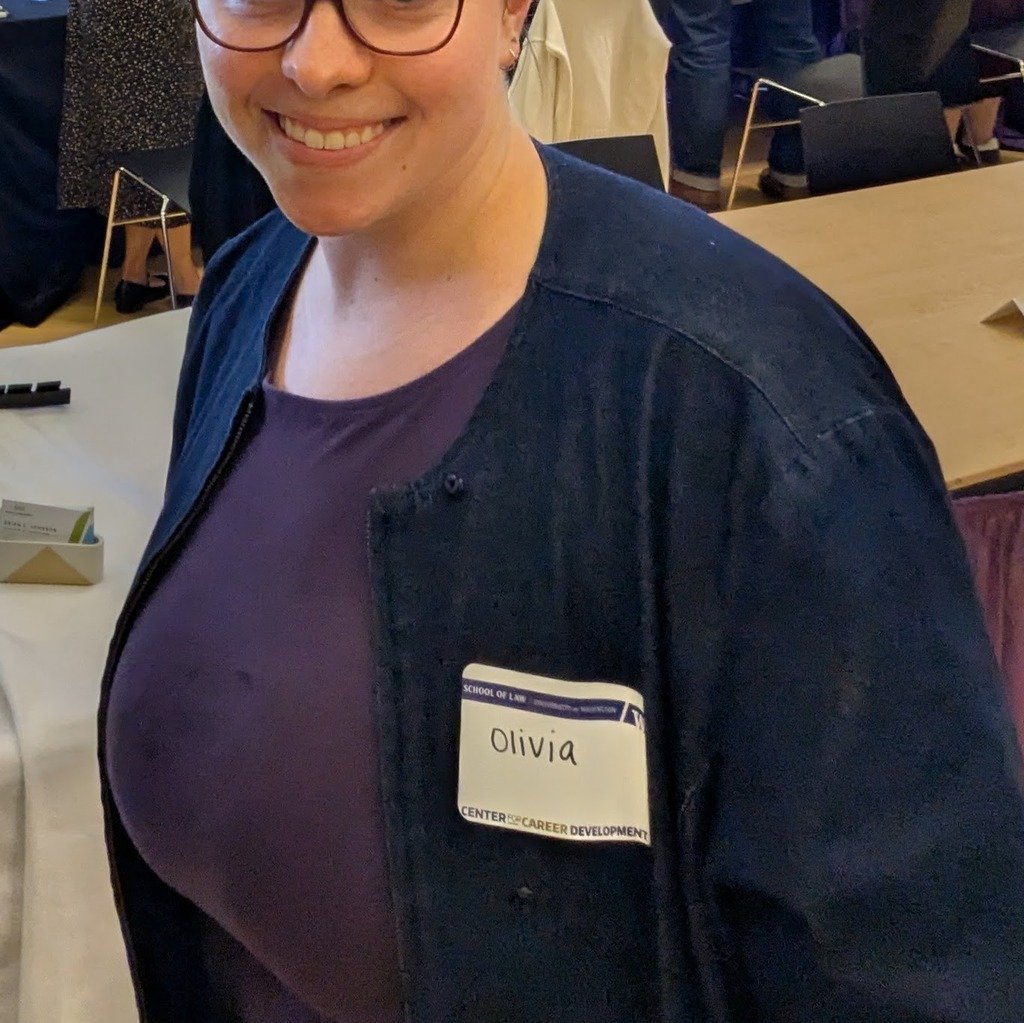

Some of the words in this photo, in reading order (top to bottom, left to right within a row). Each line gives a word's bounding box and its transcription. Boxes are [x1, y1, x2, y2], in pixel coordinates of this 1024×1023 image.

[463, 684, 494, 698] SCHOOL
[496, 690, 508, 699] OF
[509, 693, 527, 703] LAW
[490, 727, 577, 766] Olivia
[461, 805, 507, 823] CENTER
[521, 816, 569, 835] CAREER
[570, 824, 649, 841] DEVELOPMENT
